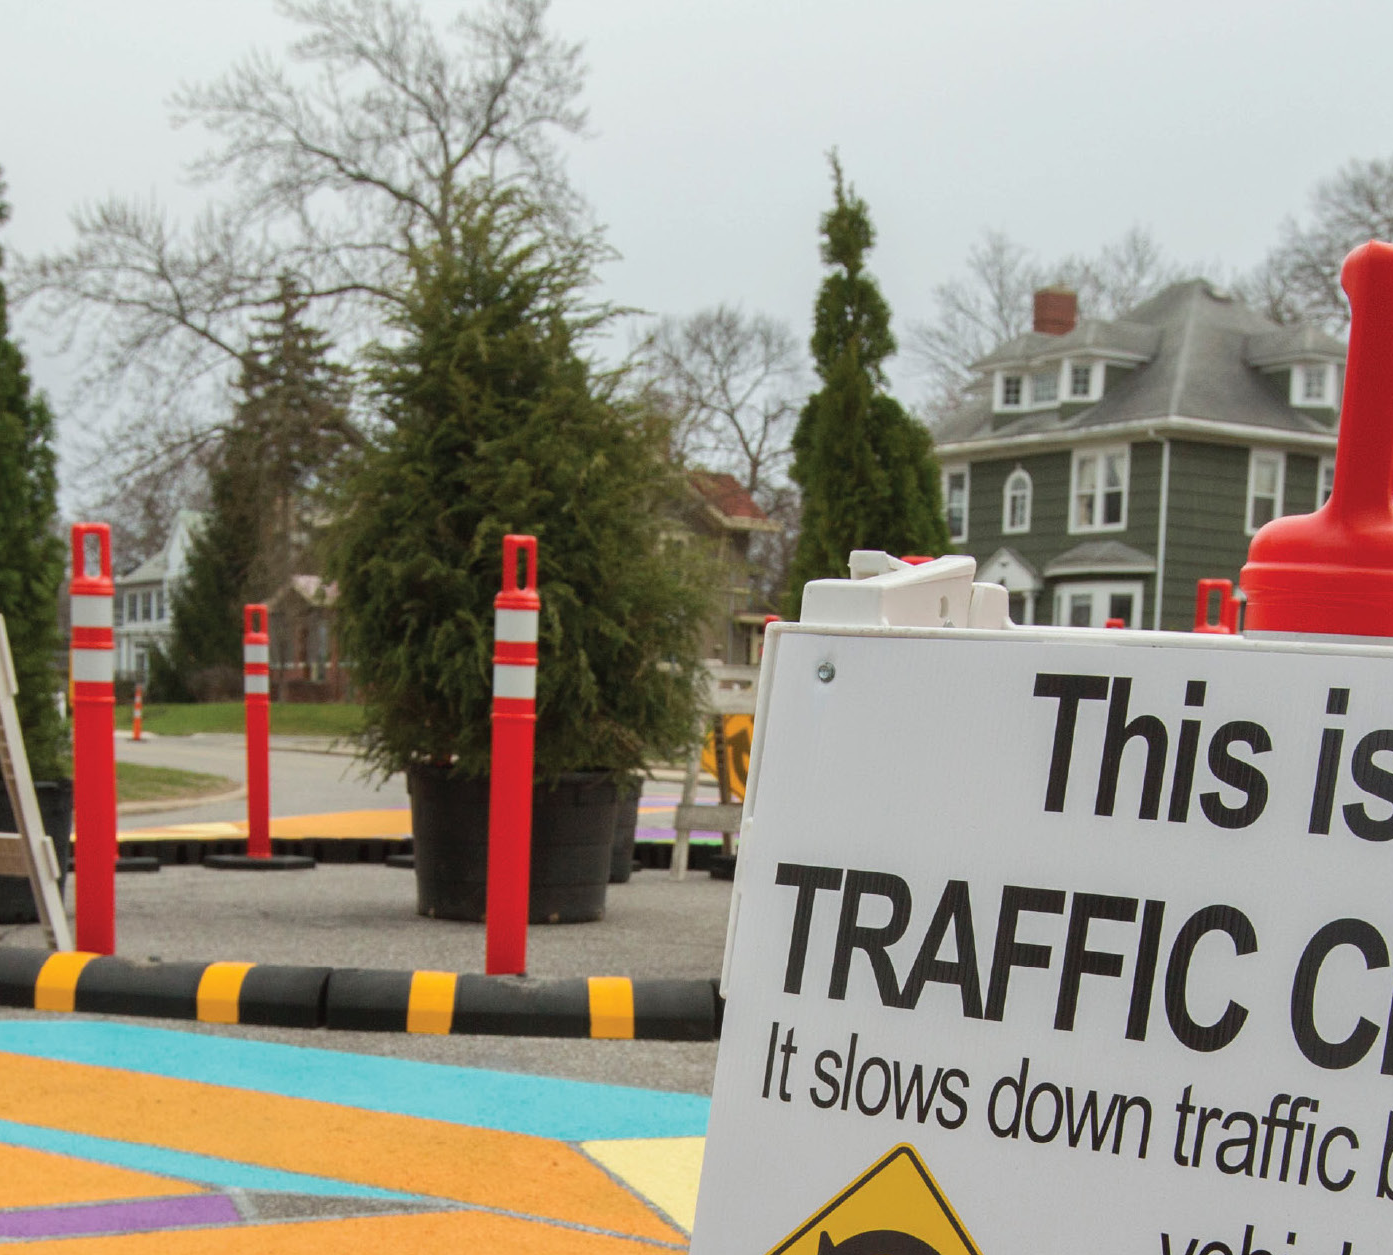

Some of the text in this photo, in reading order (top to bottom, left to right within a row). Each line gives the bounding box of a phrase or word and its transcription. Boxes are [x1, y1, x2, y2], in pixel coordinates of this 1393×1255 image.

[1032, 671, 1274, 831] This
[773, 861, 1259, 1054] TRAFFIC
[760, 1020, 799, 1104] It
[808, 1031, 971, 1131] slows
[986, 1056, 1153, 1161] down
[1172, 1083, 1361, 1193] traffic
